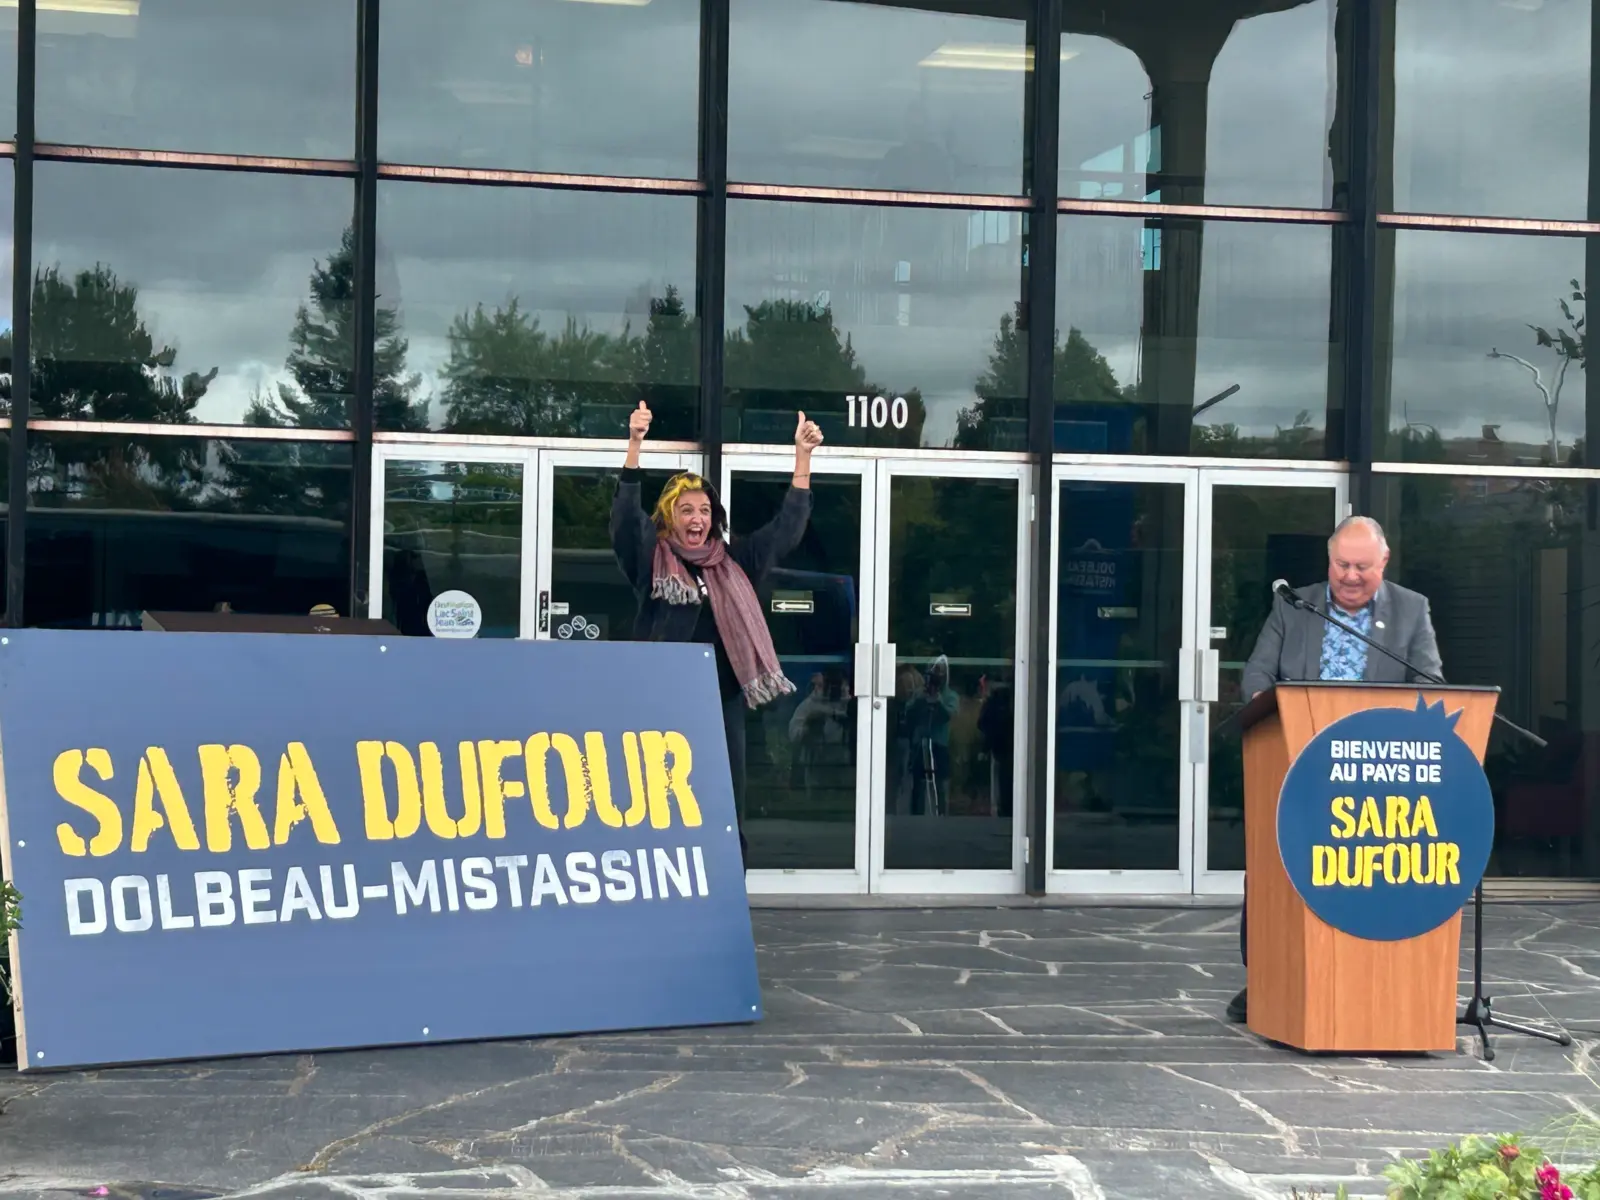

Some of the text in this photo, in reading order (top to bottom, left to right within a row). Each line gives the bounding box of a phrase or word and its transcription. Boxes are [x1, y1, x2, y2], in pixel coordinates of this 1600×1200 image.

[845, 395, 909, 429] 1100
[1330, 740, 1442, 760] BIENVENUE
[53, 731, 703, 857] SARA DUFOUR
[1329, 763, 1442, 783] AU PAYS DE
[1330, 795, 1438, 839] SARA
[1311, 842, 1461, 888] DUFOUR
[64, 846, 709, 936] DOLBEAU-MISTASSINI
